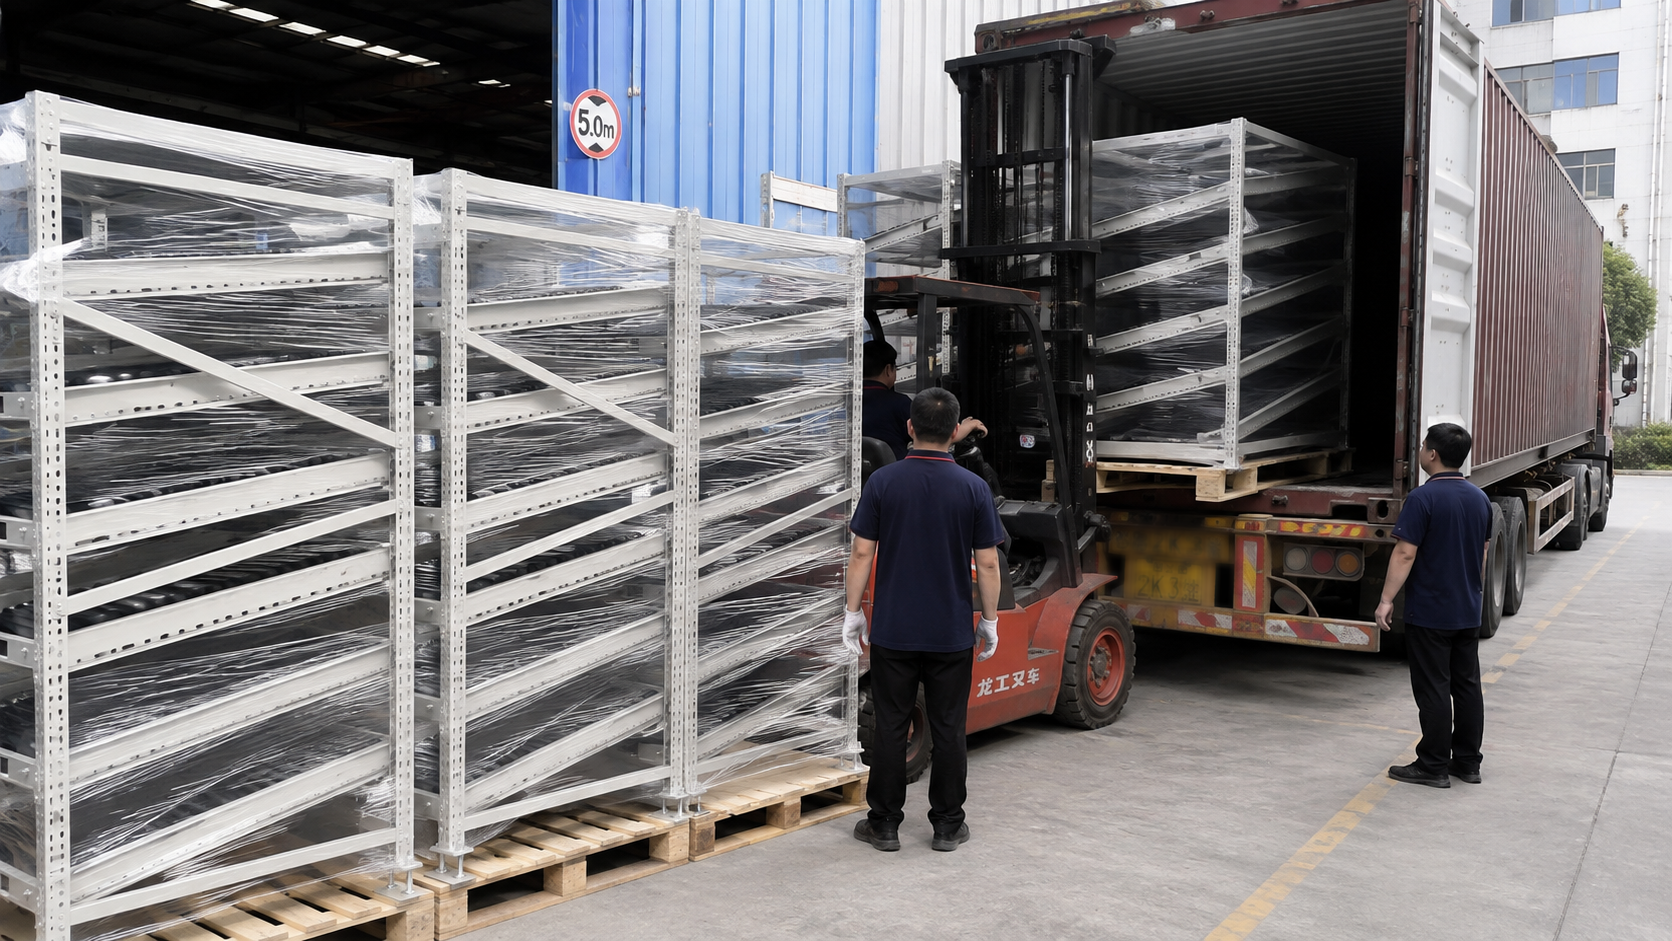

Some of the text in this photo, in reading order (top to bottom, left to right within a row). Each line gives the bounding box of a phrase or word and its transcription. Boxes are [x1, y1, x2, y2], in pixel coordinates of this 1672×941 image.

[578, 108, 615, 139] 5.0m
[976, 667, 1040, 698] 龙工叉车
